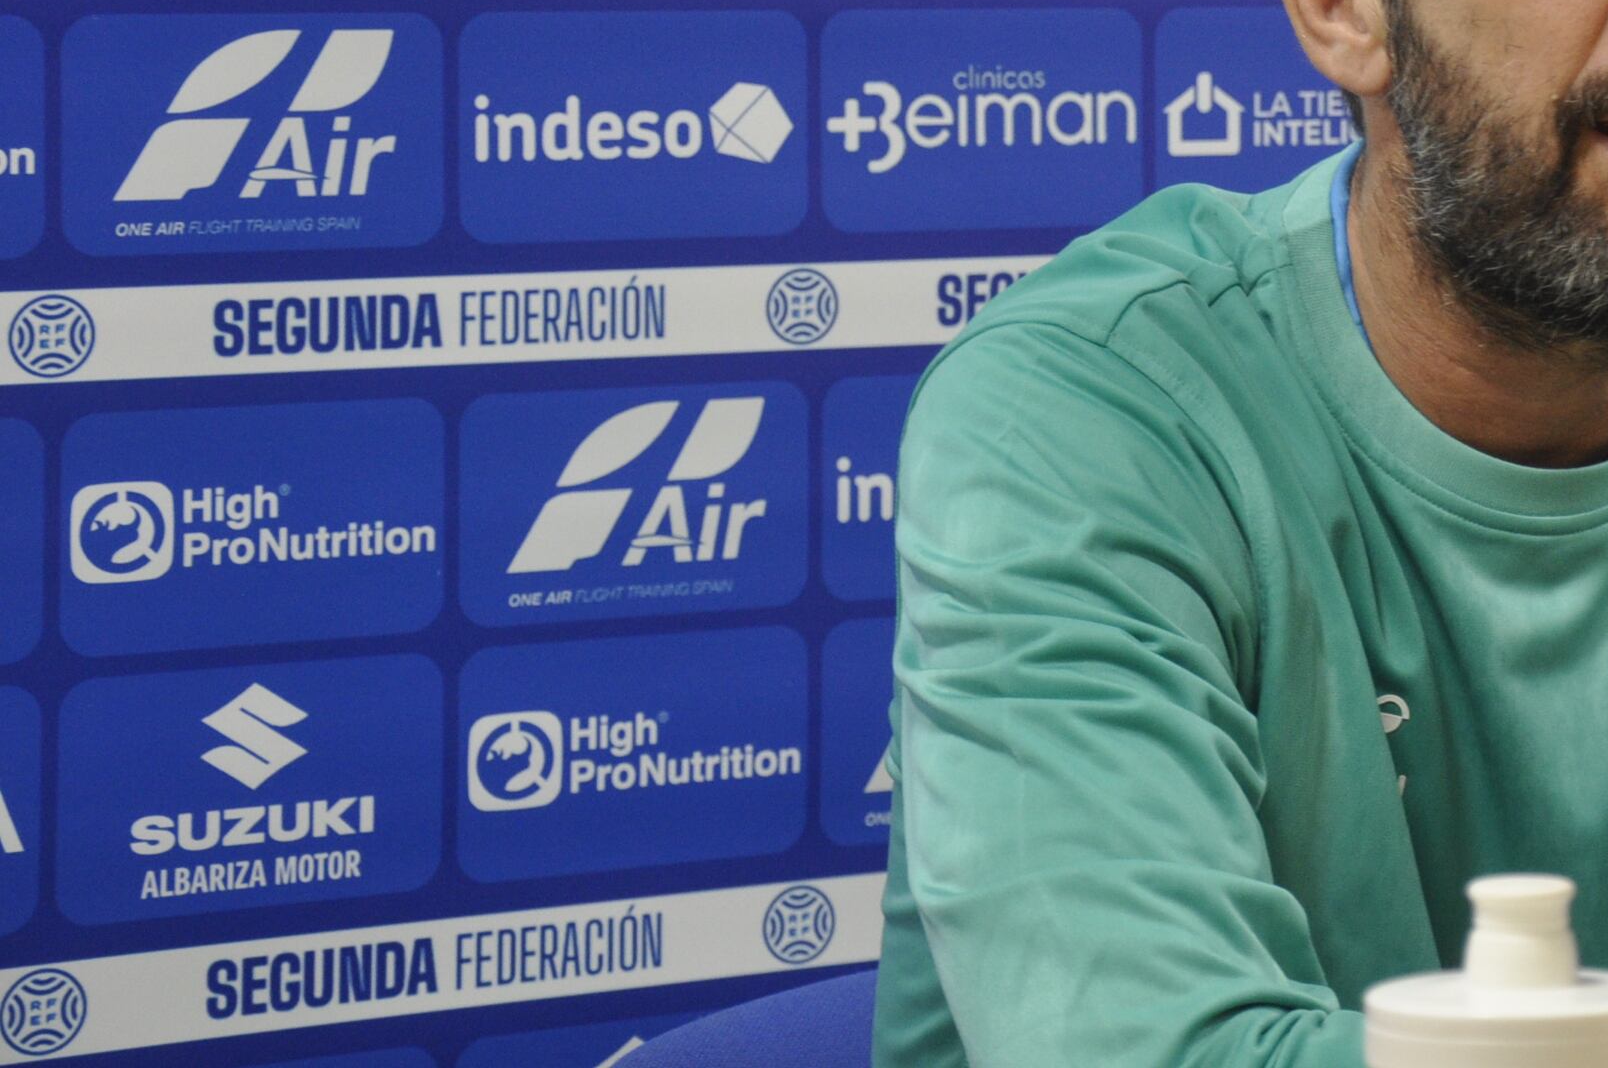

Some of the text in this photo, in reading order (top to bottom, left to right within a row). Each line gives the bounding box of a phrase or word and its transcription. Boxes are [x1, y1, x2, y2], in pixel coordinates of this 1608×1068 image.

[1253, 90, 1345, 117] LA TIE
[475, 95, 702, 162] indeso
[1253, 119, 1352, 147] INTELI
[240, 116, 396, 198] Air
[116, 217, 360, 236] ONE AIR FLIGHT TRAINING SPAIN
[213, 276, 665, 357] SEGUNDA FEDERACIÓN
[183, 521, 435, 567] ProNutrition
[622, 483, 766, 566] Air
[509, 579, 733, 607] ONE AIR FLIGHT TRAINING SPAIN
[570, 744, 800, 793] ProNutrition
[130, 796, 374, 855] SUZUKI
[141, 850, 360, 899] ALBARIZA MOTOR
[206, 906, 662, 1020] SEGUNDA FEDERACIÓN
